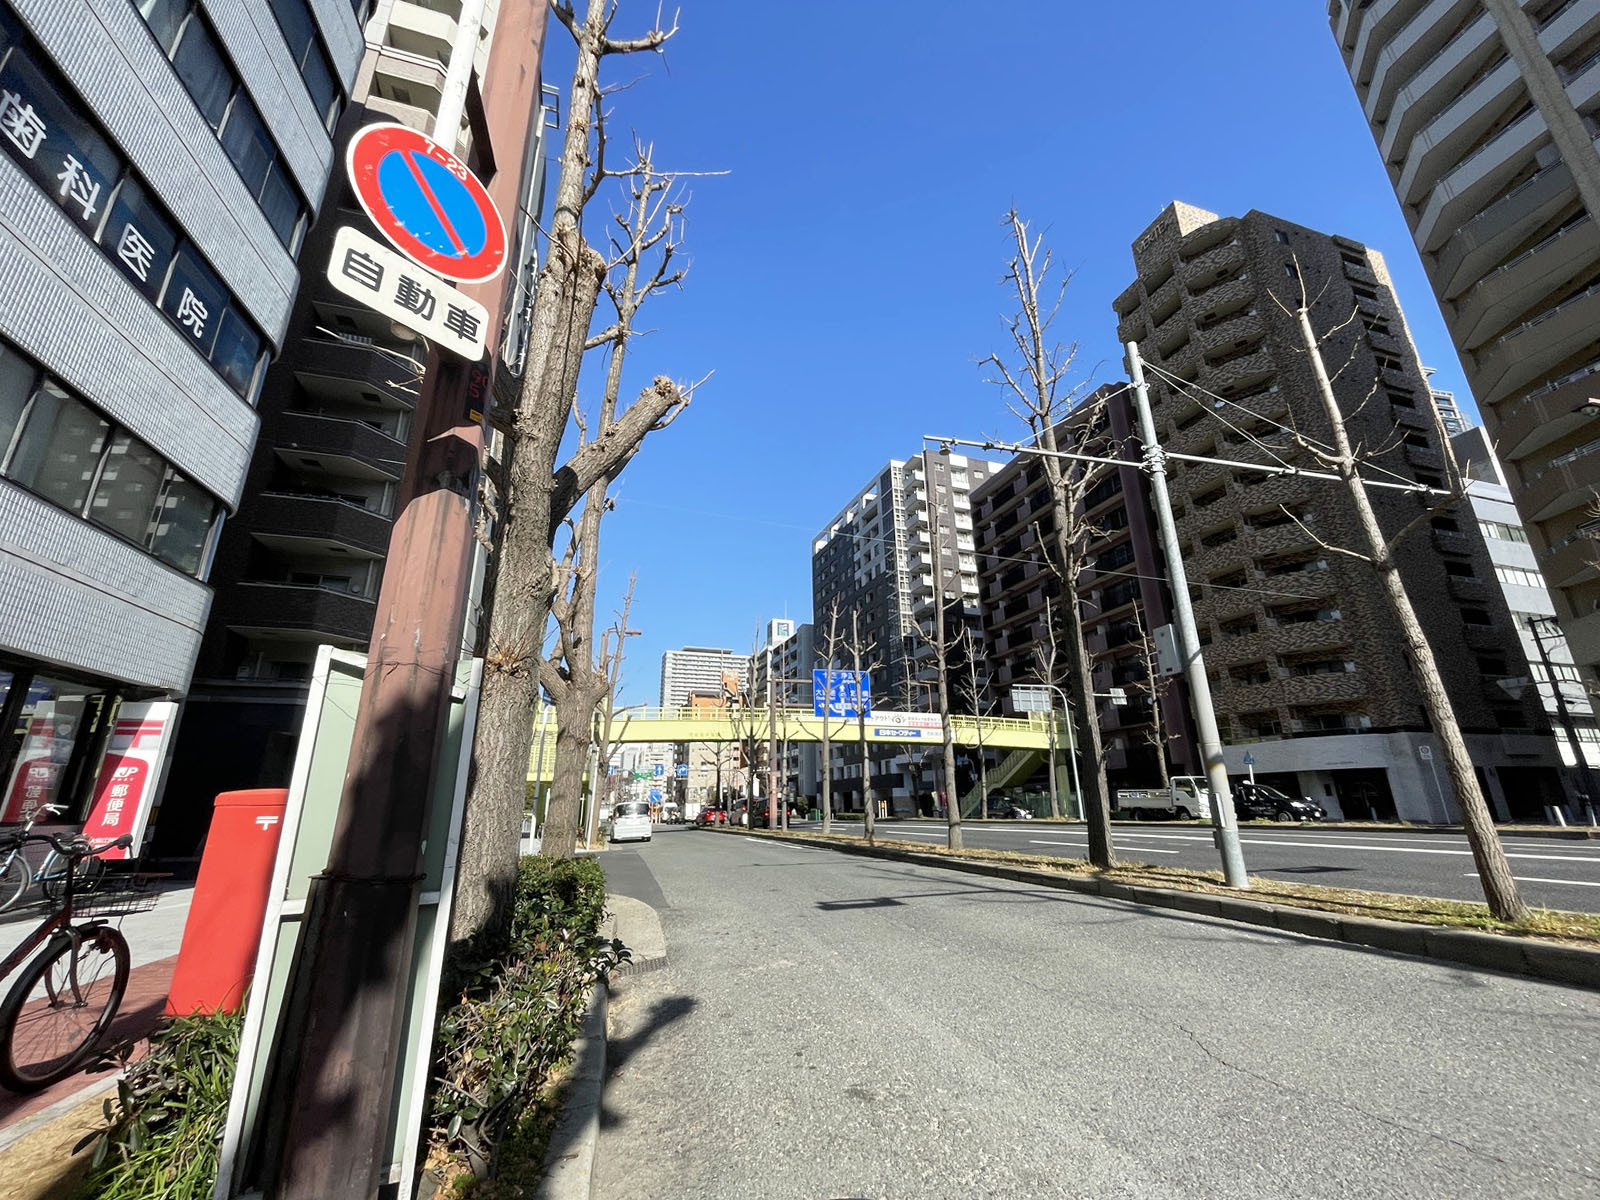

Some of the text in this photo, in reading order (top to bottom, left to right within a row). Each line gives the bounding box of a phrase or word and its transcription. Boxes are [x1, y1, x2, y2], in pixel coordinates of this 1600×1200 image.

[423, 138, 468, 181] 7-23
[0, 89, 209, 338] 歯科医院
[342, 247, 482, 344] 自動車
[101, 784, 129, 827] 郵便局
